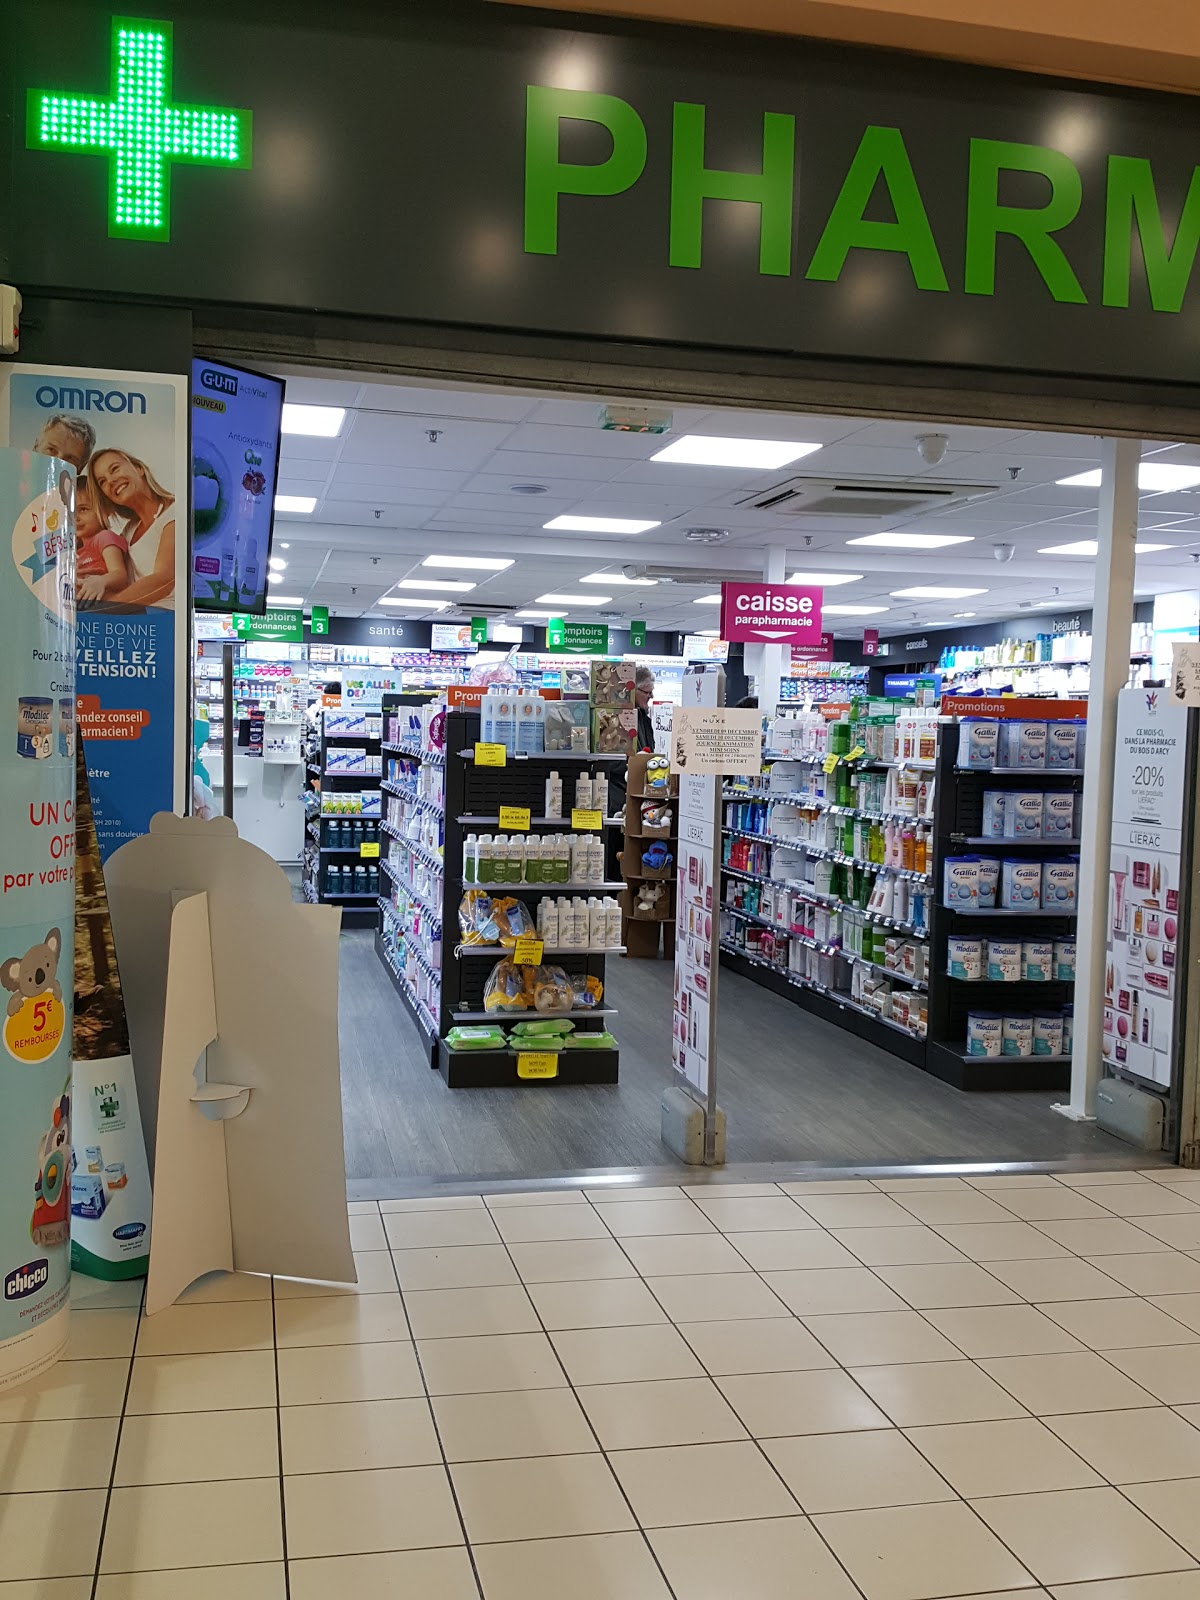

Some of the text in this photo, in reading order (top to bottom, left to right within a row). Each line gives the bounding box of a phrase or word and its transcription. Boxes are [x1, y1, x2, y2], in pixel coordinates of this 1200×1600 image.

[36, 385, 147, 415] OMRON
[228, 432, 273, 448] Antioxydants
[736, 591, 813, 613] caisse
[237, 619, 245, 629] 2
[735, 614, 813, 627] parapharmacie
[1053, 616, 1080, 632] beauté
[105, 623, 157, 637] BONNE
[316, 622, 324, 633] 3
[369, 625, 403, 636] santé
[475, 632, 482, 642] 4
[553, 634, 561, 645] 5
[634, 636, 641, 646] 6
[104, 637, 125, 649] DE
[131, 638, 156, 650] VIE
[797, 645, 828, 653] ordonnance
[867, 643, 874, 653] 8
[906, 638, 928, 650] conseils
[32, 649, 59, 662] Pour 2
[947, 701, 1006, 712] Promotions
[108, 711, 143, 723] conseil
[974, 727, 997, 737] Gallia
[1024, 728, 1046, 737] Gallia
[1054, 729, 1076, 738] Gallia
[1125, 737, 1139, 745] DANS
[1146, 738, 1176, 746] PHARMACIE
[1132, 765, 1164, 787] -20%
[1019, 798, 1042, 808] Gallia
[1050, 799, 1073, 809] Gallia
[30, 802, 58, 826] UN
[1130, 832, 1161, 847] LIERAC
[952, 867, 977, 877] Gallia
[1016, 869, 1039, 878] Gallia
[1050, 869, 1074, 878] Gallia
[4, 872, 34, 893] par
[39, 865, 67, 885] votre
[94, 1082, 118, 1097] N°1
[115, 1225, 143, 1236] HARTMANN
[7, 1266, 47, 1296] chicco
[19, 1302, 43, 1318] DEMANDEZ
